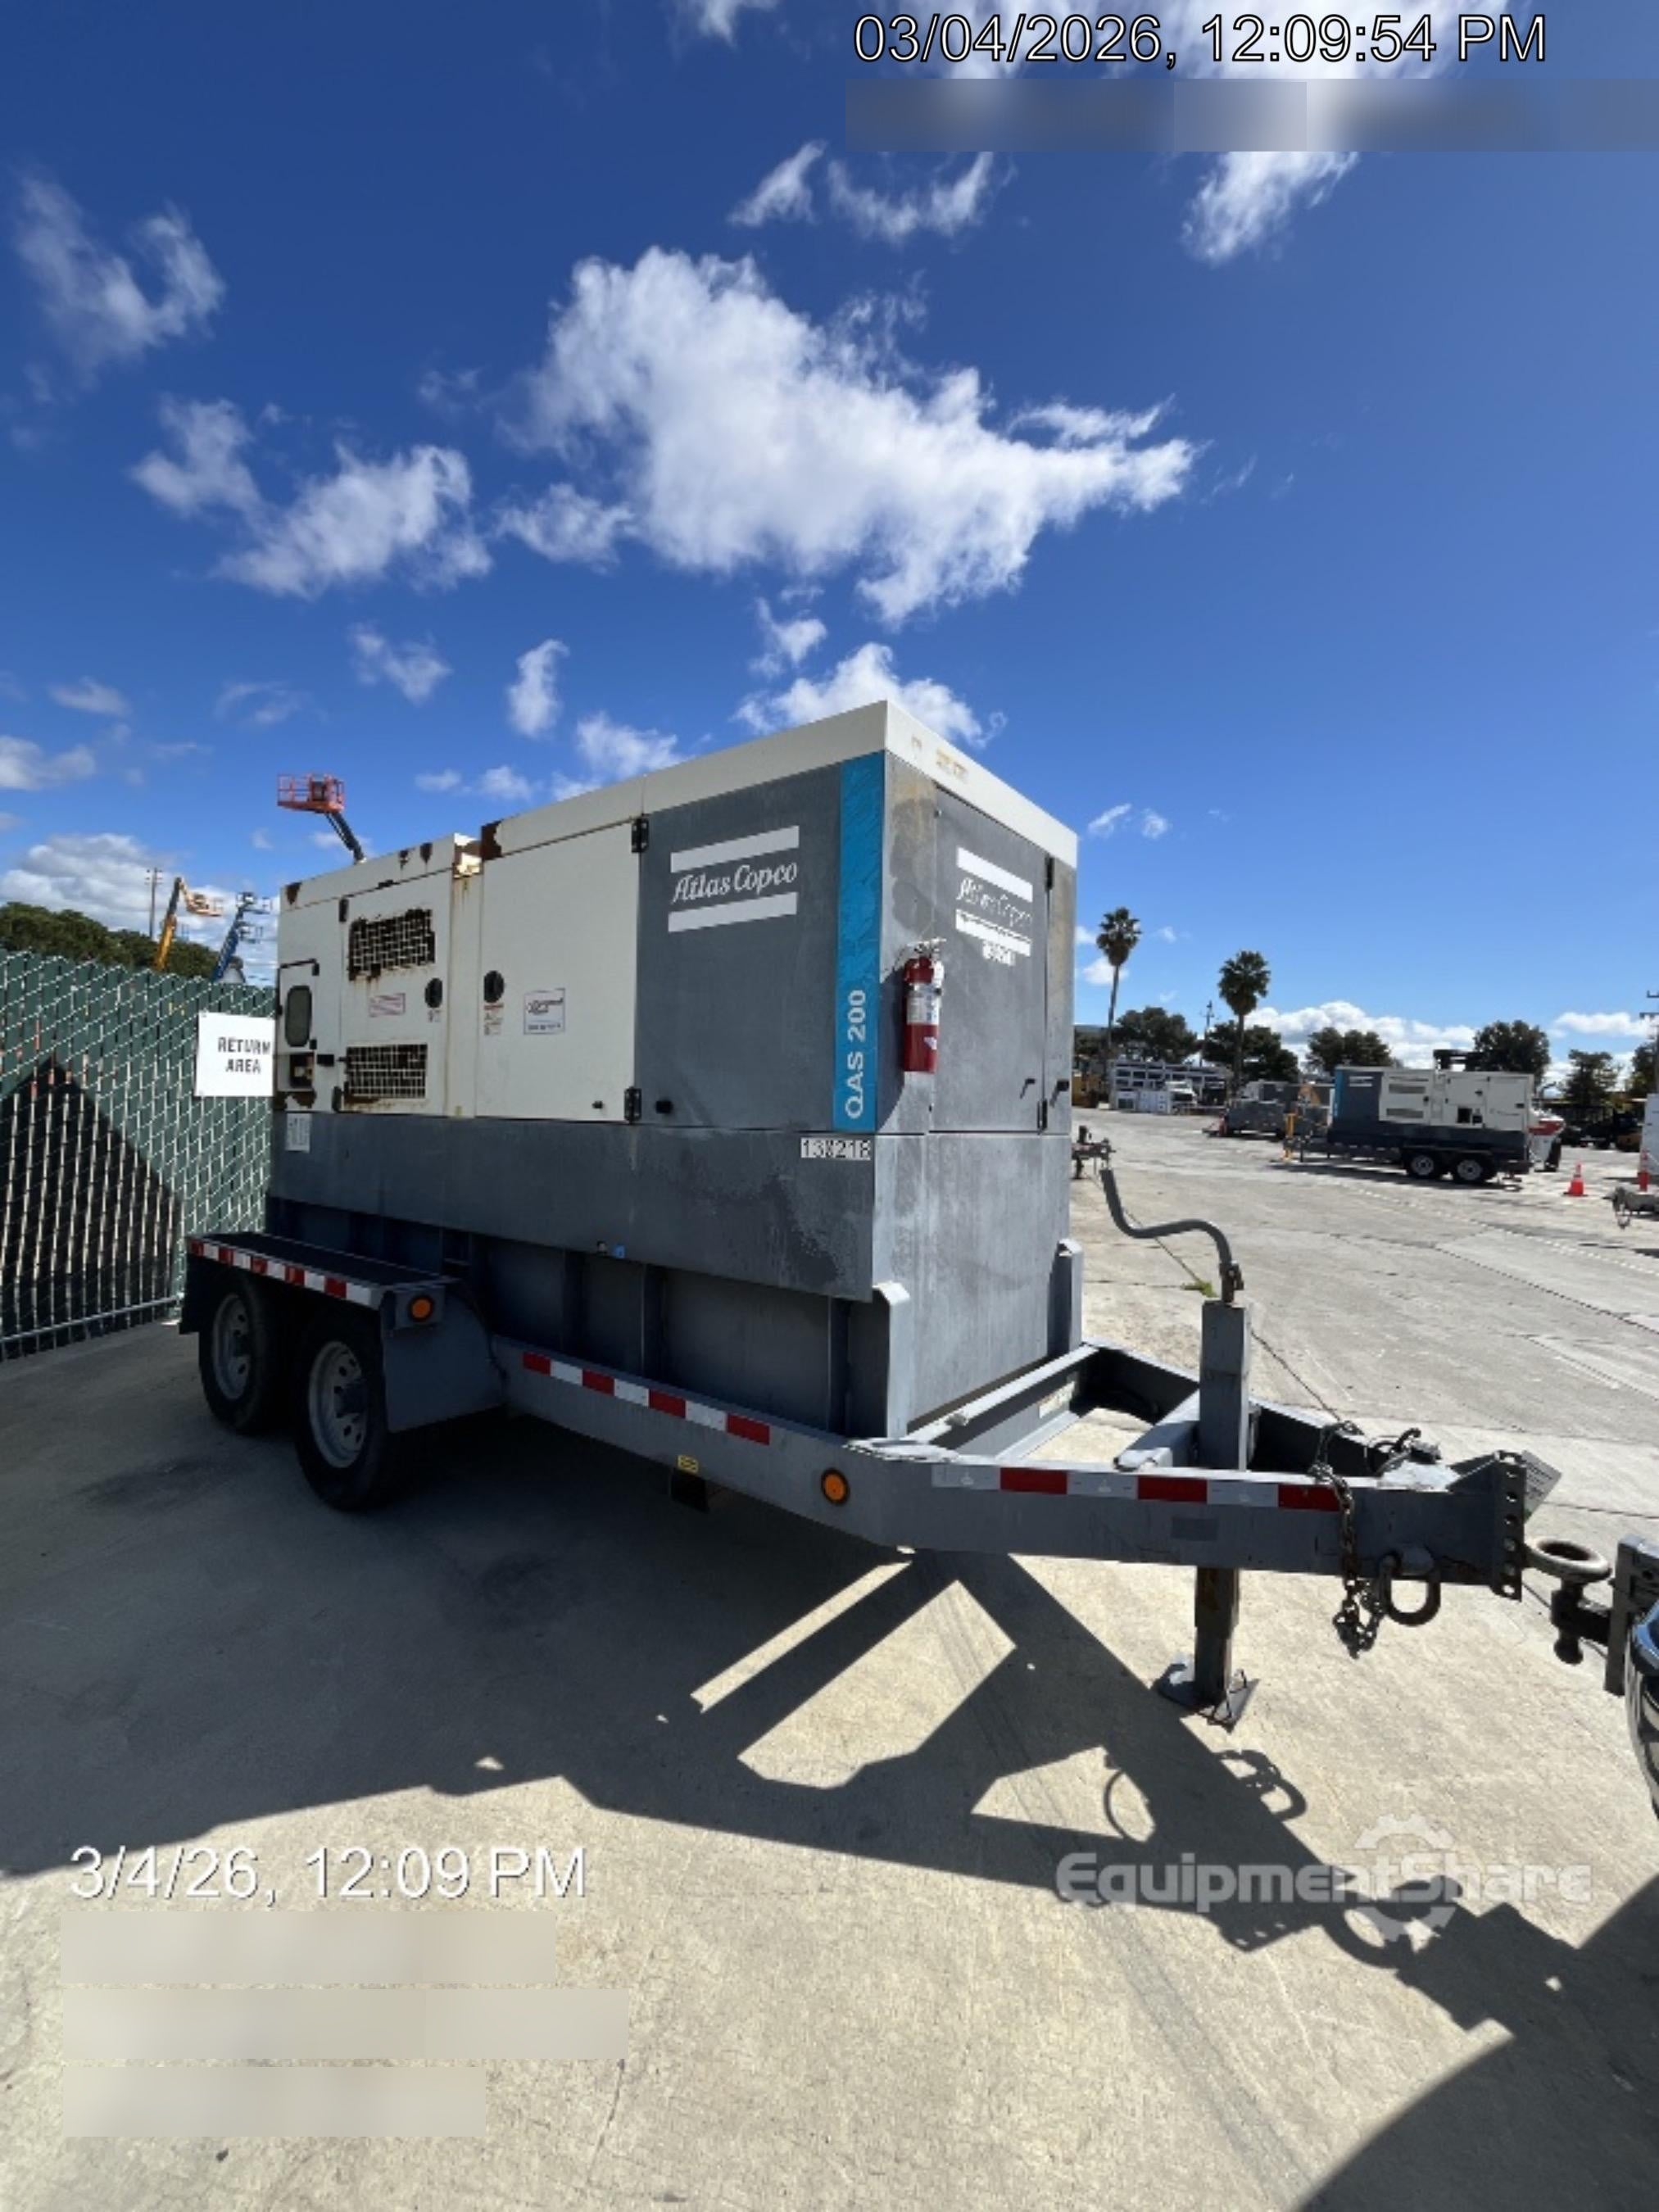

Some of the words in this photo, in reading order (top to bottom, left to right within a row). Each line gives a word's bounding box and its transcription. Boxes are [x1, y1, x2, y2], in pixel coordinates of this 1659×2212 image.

[671, 870, 730, 904] Atlas
[733, 862, 797, 895] Copco
[847, 990, 866, 1042] 200
[217, 1036, 270, 1055] RETURN
[225, 1058, 261, 1074] AREA
[845, 1051, 863, 1119] QAS
